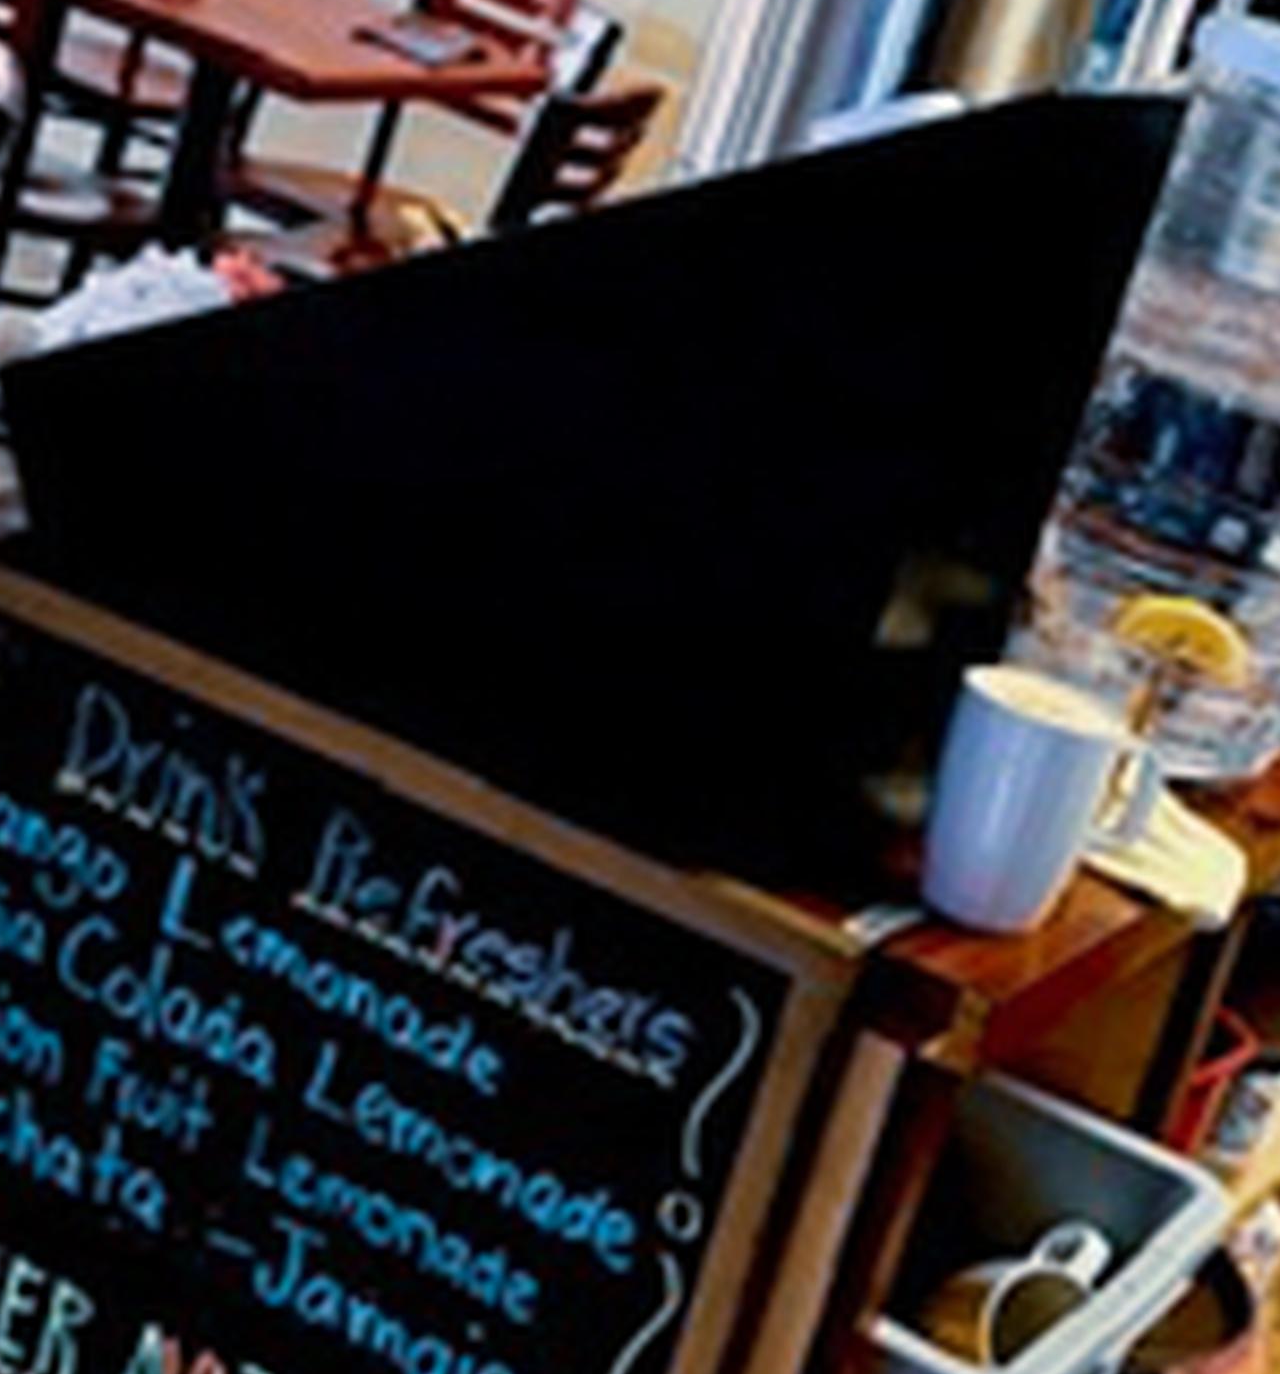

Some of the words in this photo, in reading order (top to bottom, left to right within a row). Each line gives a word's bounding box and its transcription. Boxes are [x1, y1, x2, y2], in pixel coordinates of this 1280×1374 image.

[65, 682, 264, 866] Drink
[306, 809, 694, 1068] Refreshers
[161, 855, 503, 1096] Lemonade
[58, 916, 275, 1086] Colada
[304, 1038, 636, 1273] Lemonade
[86, 1036, 215, 1151] Fruit
[245, 1114, 540, 1324] Lemonade
